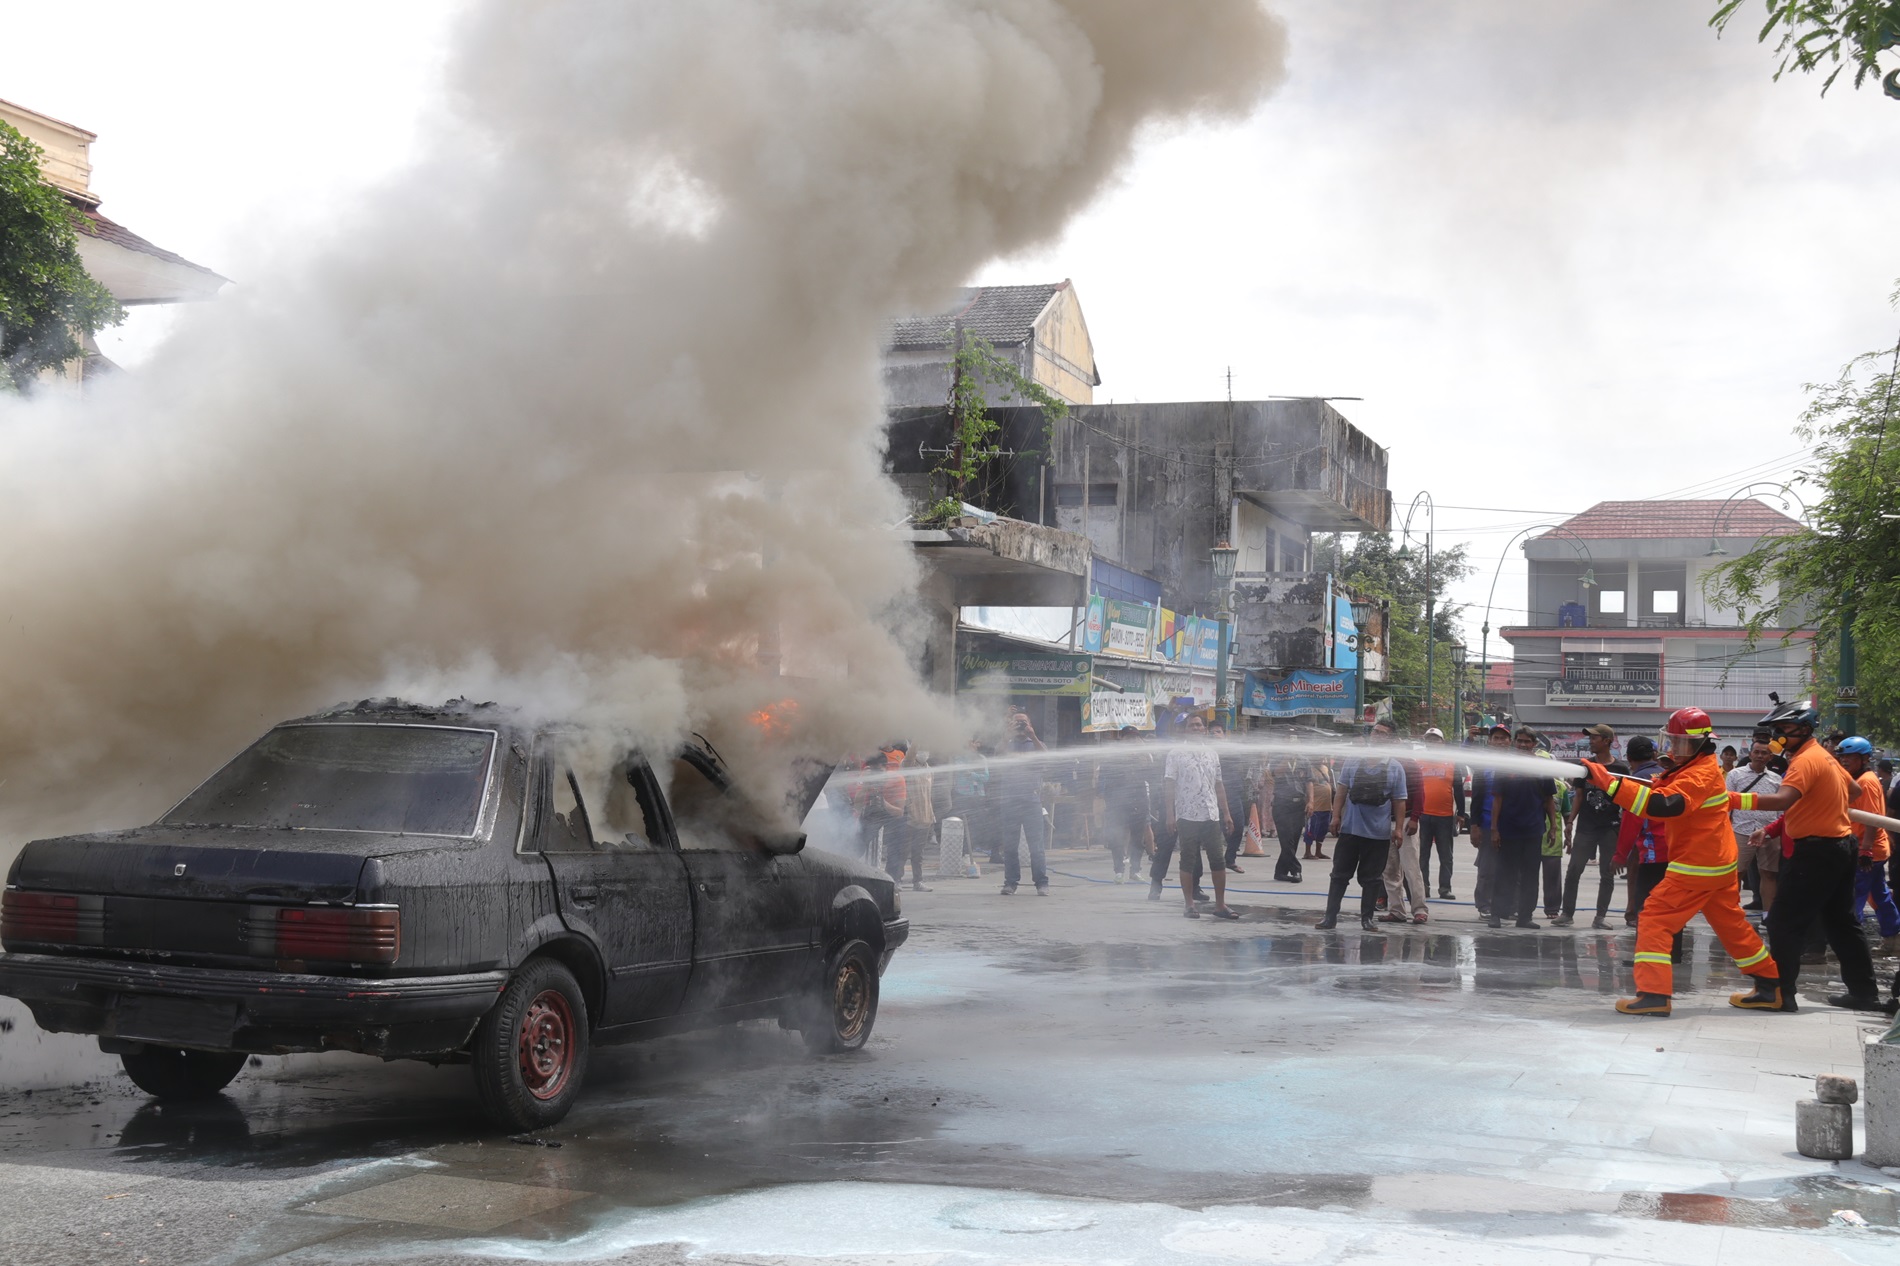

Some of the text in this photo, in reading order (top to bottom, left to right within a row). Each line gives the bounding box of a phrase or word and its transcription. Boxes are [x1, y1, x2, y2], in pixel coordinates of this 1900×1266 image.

[961, 655, 1073, 672] Warung PERWAKILAN
[1274, 680, 1343, 695] Le Minerale
[1260, 709, 1293, 717] LESEHAN
[1323, 707, 1341, 715] JAYA
